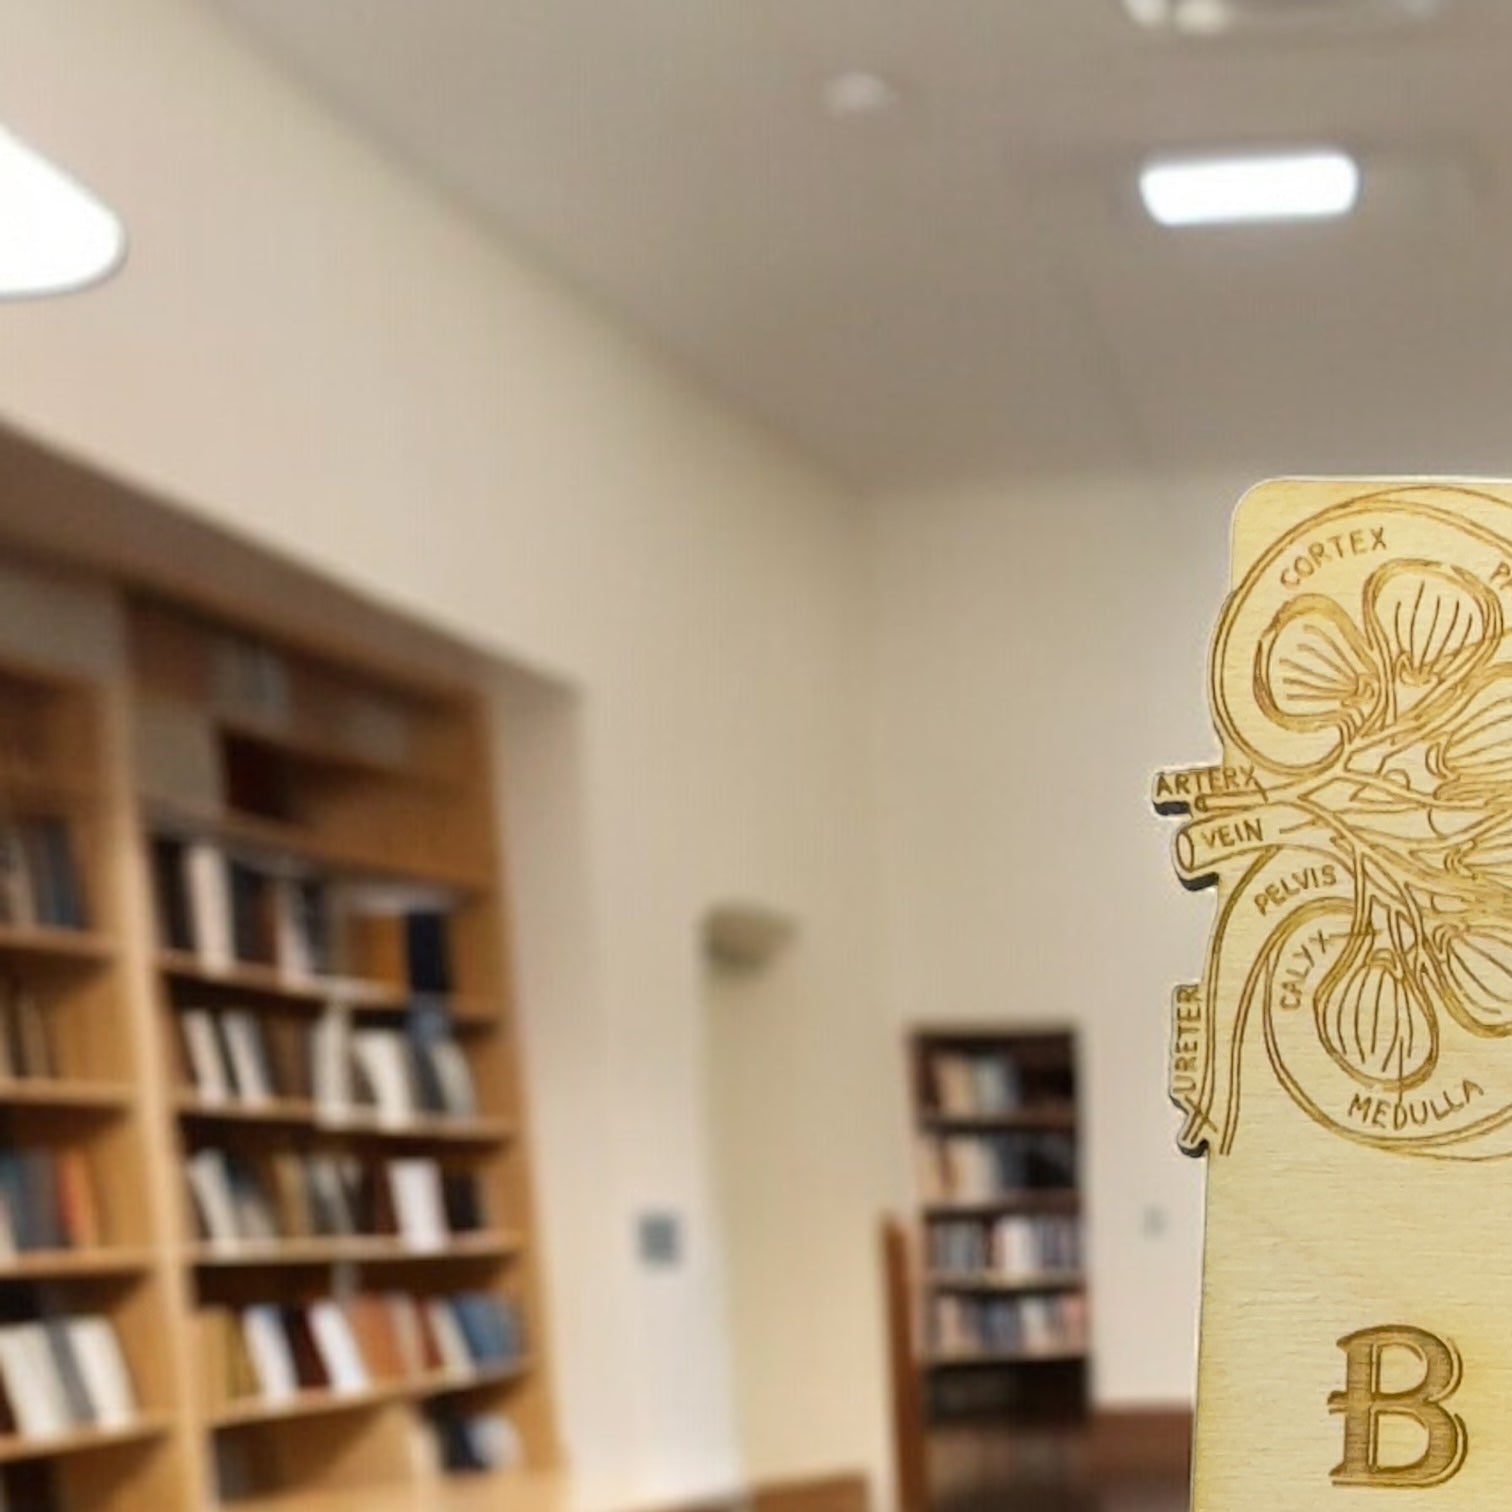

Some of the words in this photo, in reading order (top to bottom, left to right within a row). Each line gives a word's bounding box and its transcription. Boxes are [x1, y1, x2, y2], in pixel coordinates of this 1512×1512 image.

[1280, 526, 1388, 591] CORTEX
[1200, 818, 1264, 848] VEIN
[1253, 864, 1337, 916] PELVIS
[1280, 928, 1332, 1011] CALYX
[1172, 984, 1203, 1093] URETER
[1348, 1078, 1484, 1129] MEDULLA
